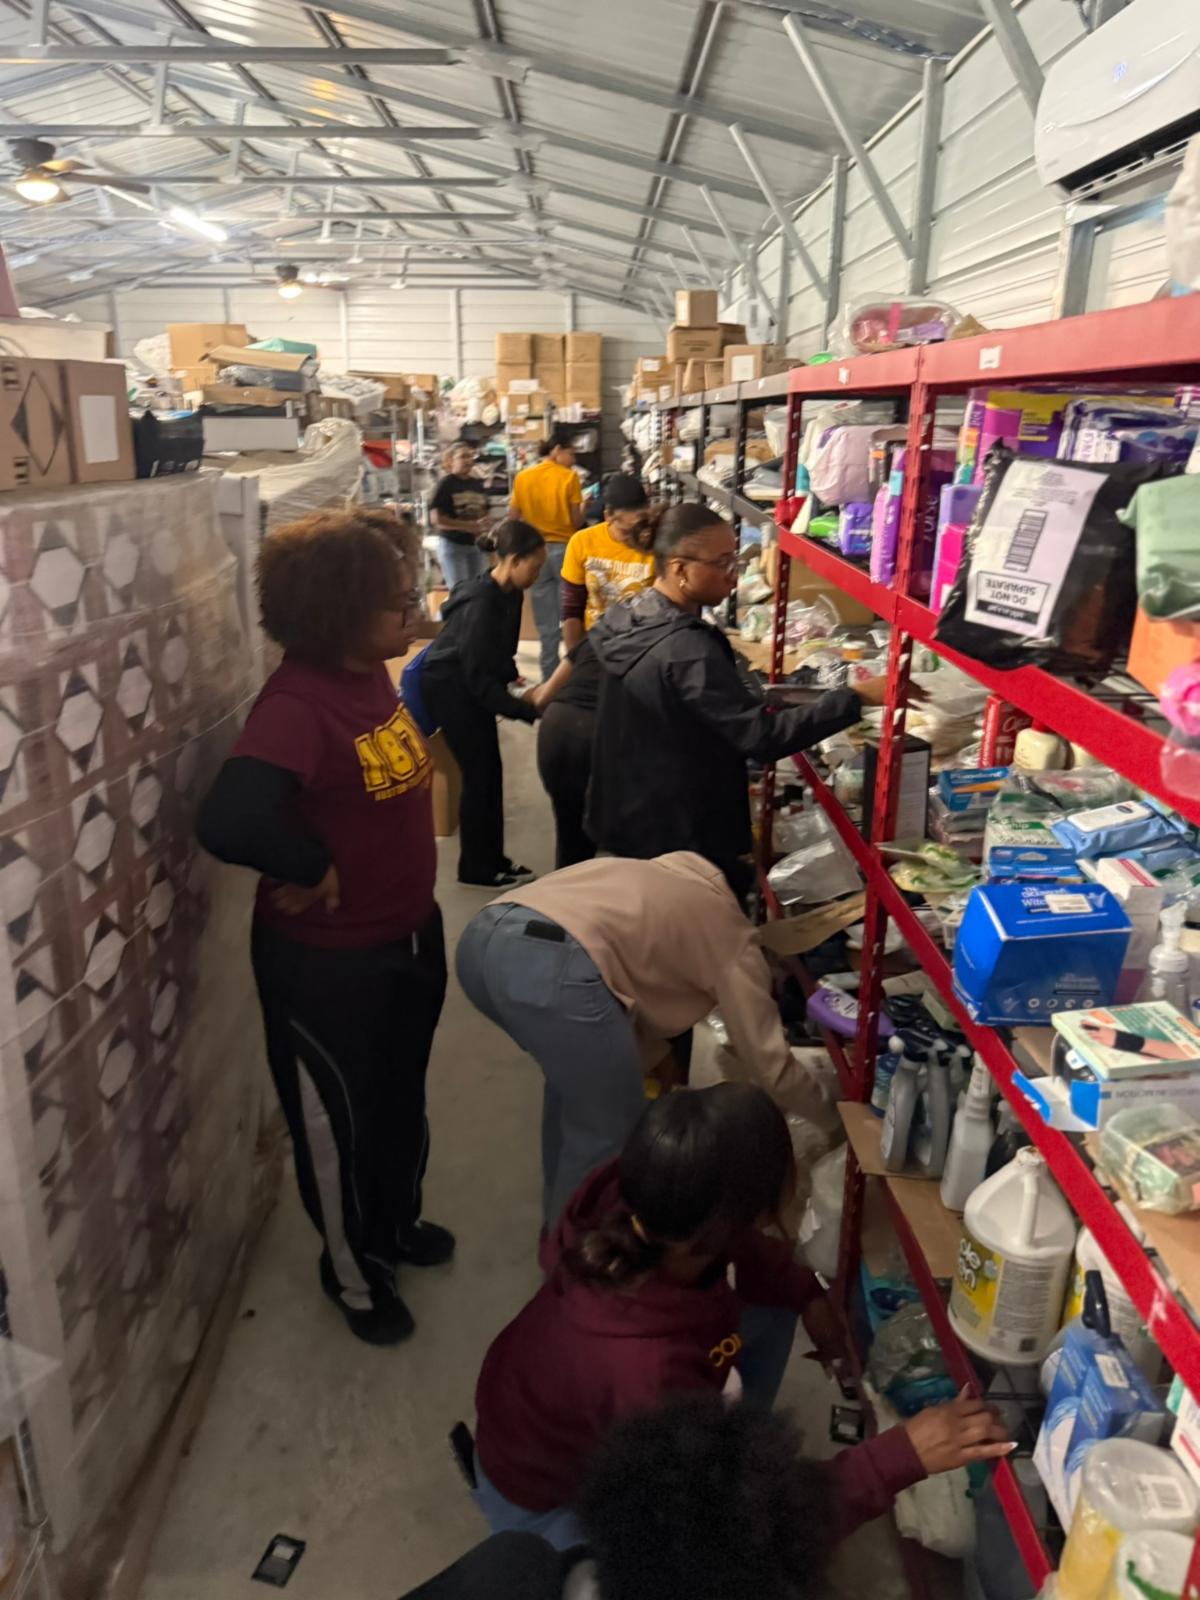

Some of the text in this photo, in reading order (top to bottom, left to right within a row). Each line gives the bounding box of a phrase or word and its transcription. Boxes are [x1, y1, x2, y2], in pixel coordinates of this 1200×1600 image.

[985, 579, 1036, 596] SEPARATE
[990, 590, 1027, 605] DO NOT
